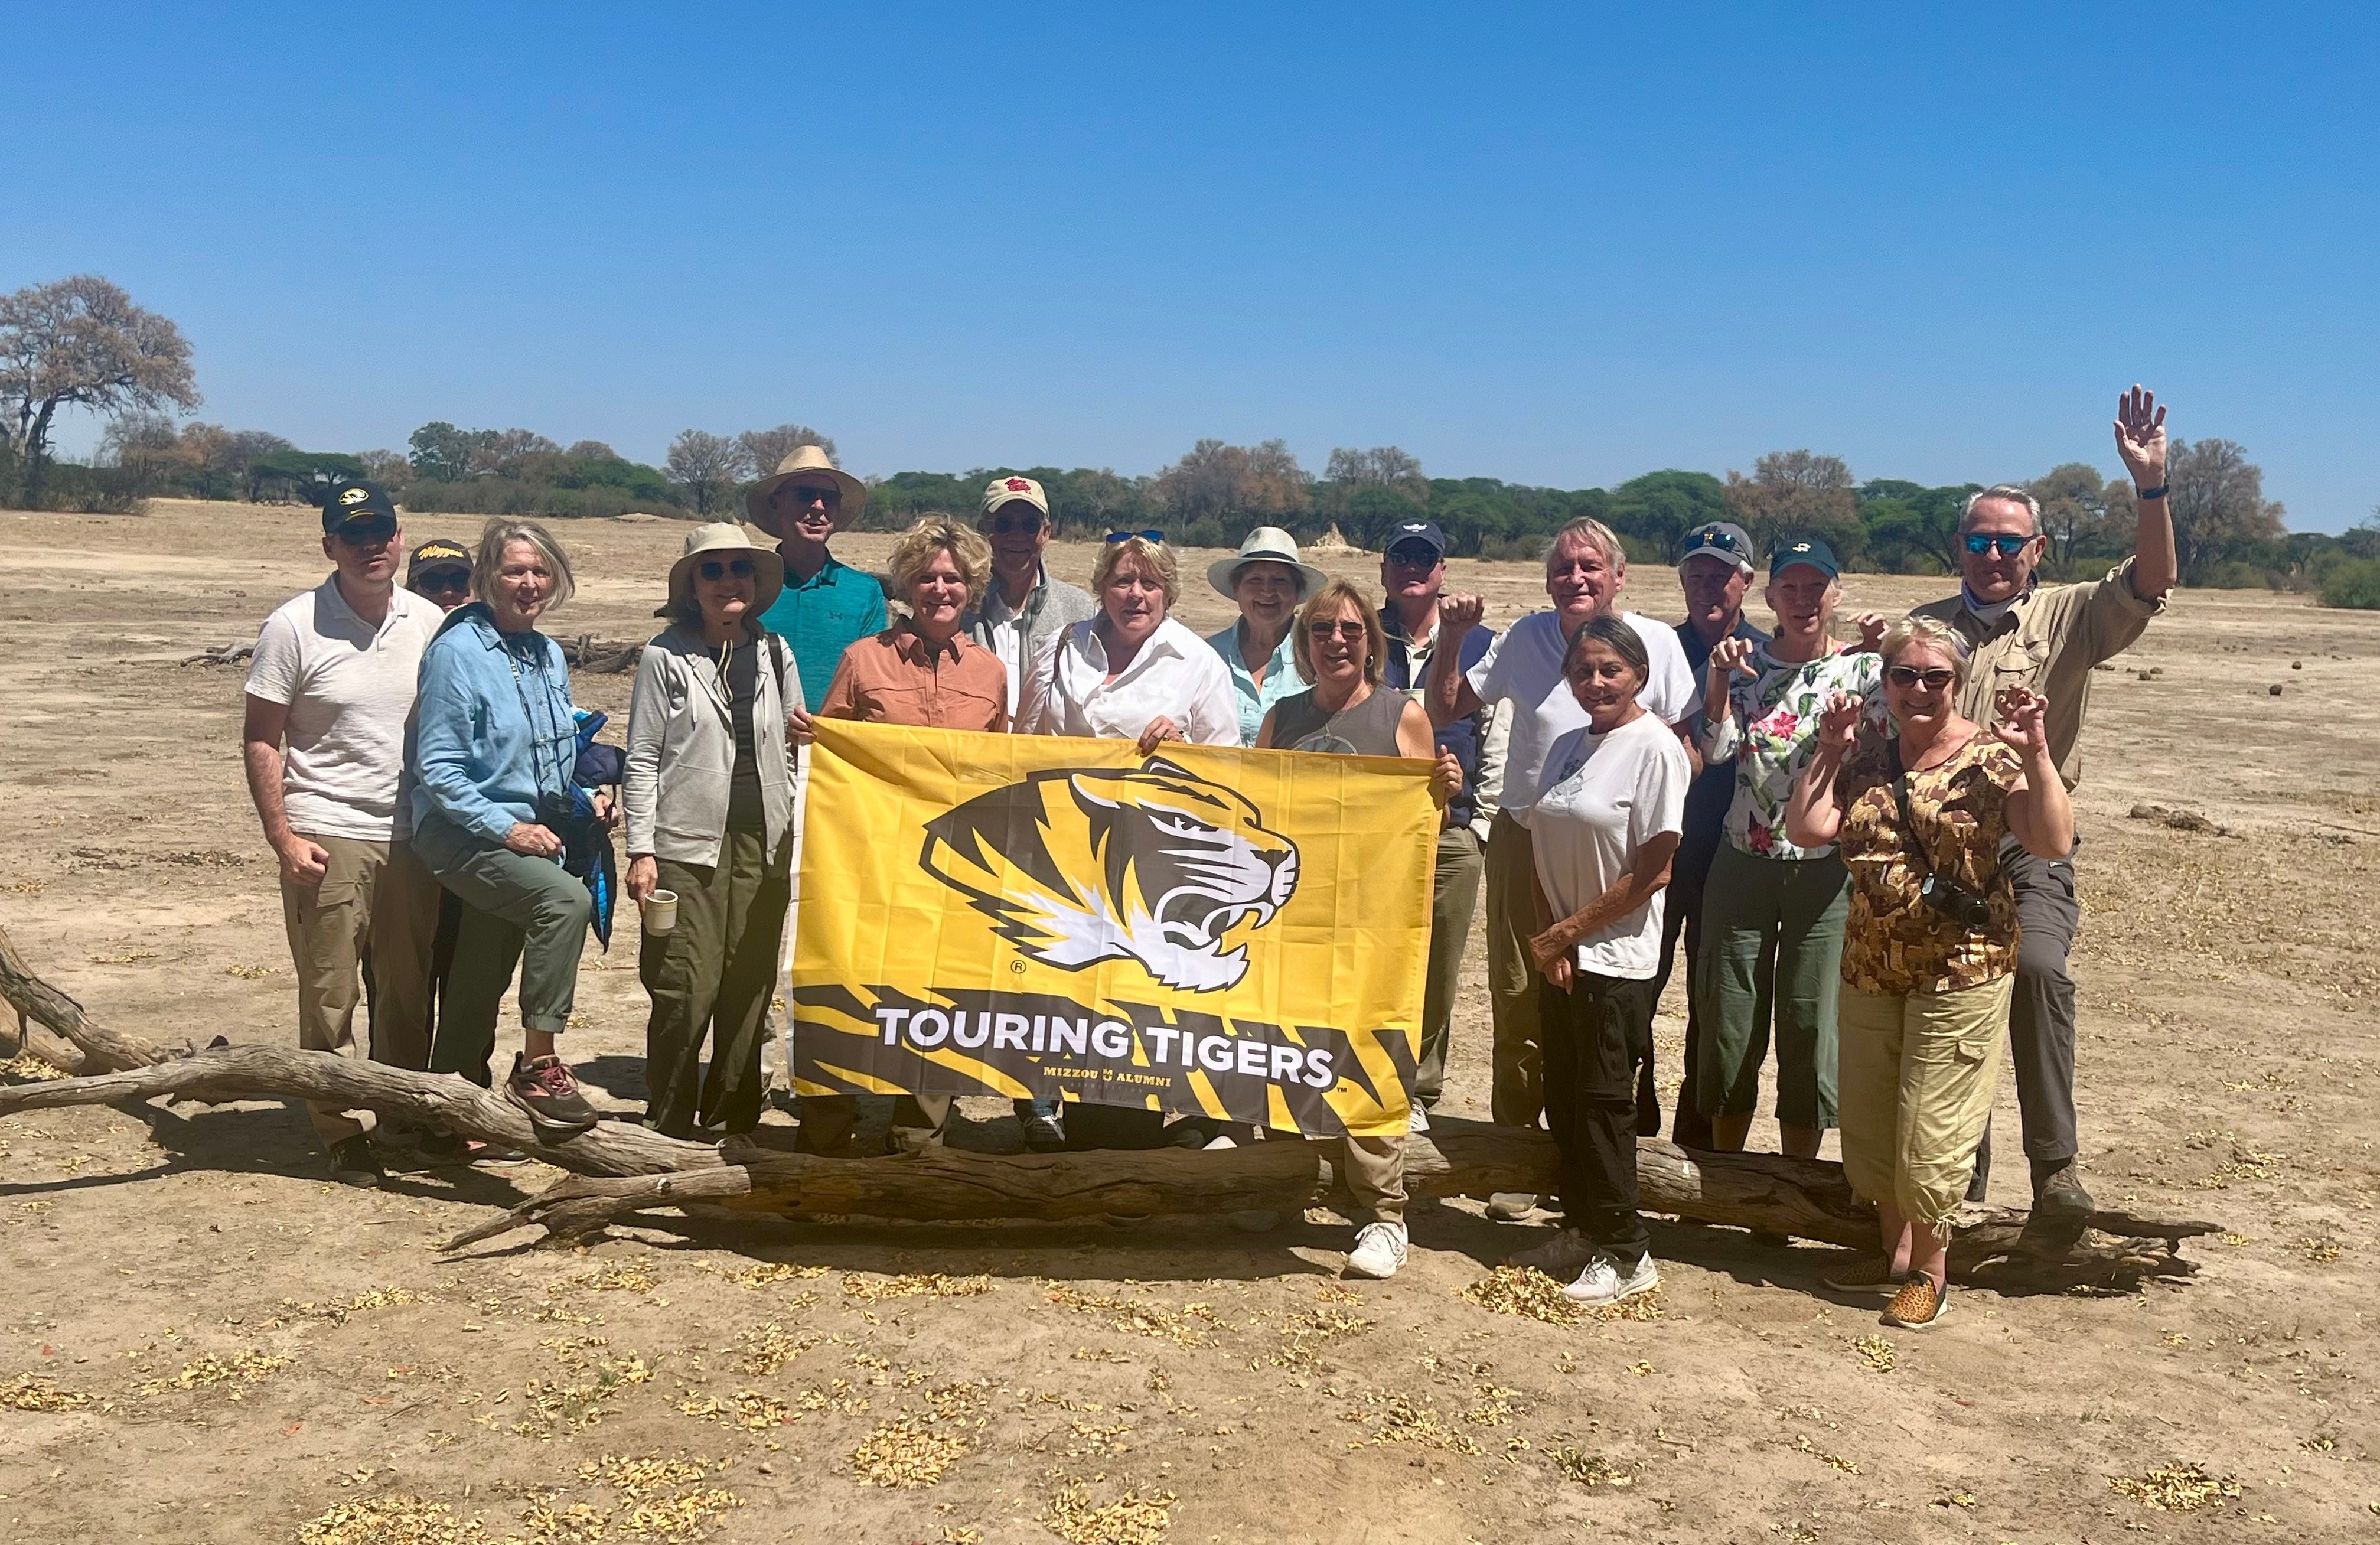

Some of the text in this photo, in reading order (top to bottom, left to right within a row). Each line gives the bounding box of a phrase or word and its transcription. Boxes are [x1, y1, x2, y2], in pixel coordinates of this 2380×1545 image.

[875, 1008, 1129, 1058] TOURING
[1146, 1026, 1334, 1088] TIGERS
[1042, 1066, 1098, 1080] MIZZOU
[1116, 1072, 1172, 1087] ALUMNI
